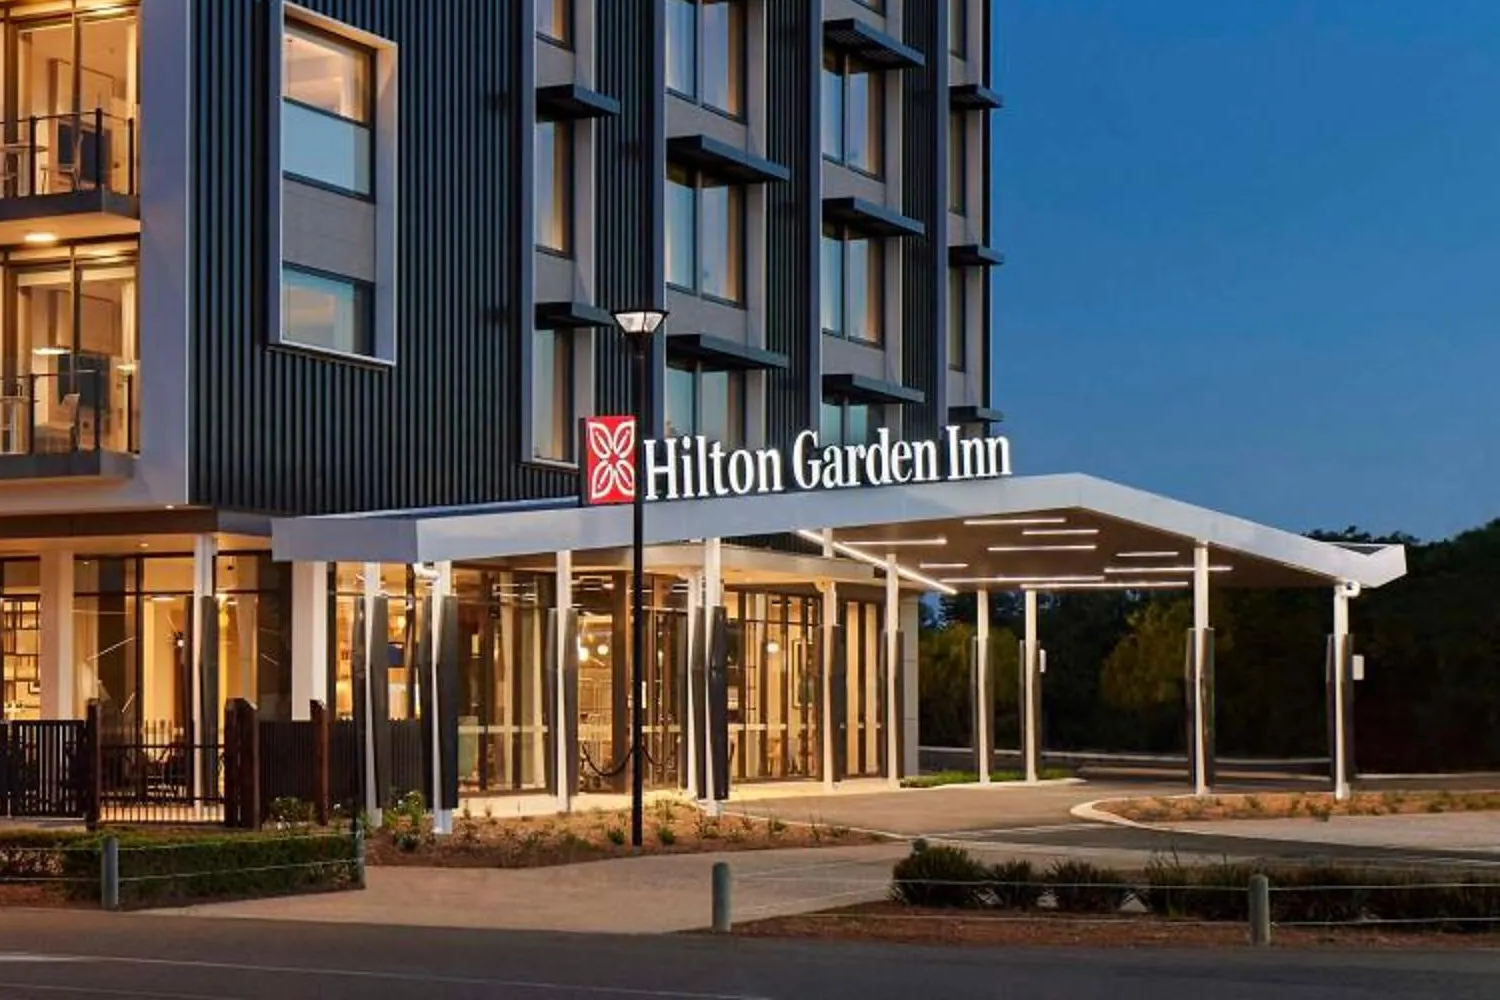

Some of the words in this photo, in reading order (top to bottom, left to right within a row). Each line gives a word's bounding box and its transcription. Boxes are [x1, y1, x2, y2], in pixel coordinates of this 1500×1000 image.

[643, 436, 783, 500] Hilton
[793, 428, 942, 489] Garden
[946, 425, 1012, 480] Inn
